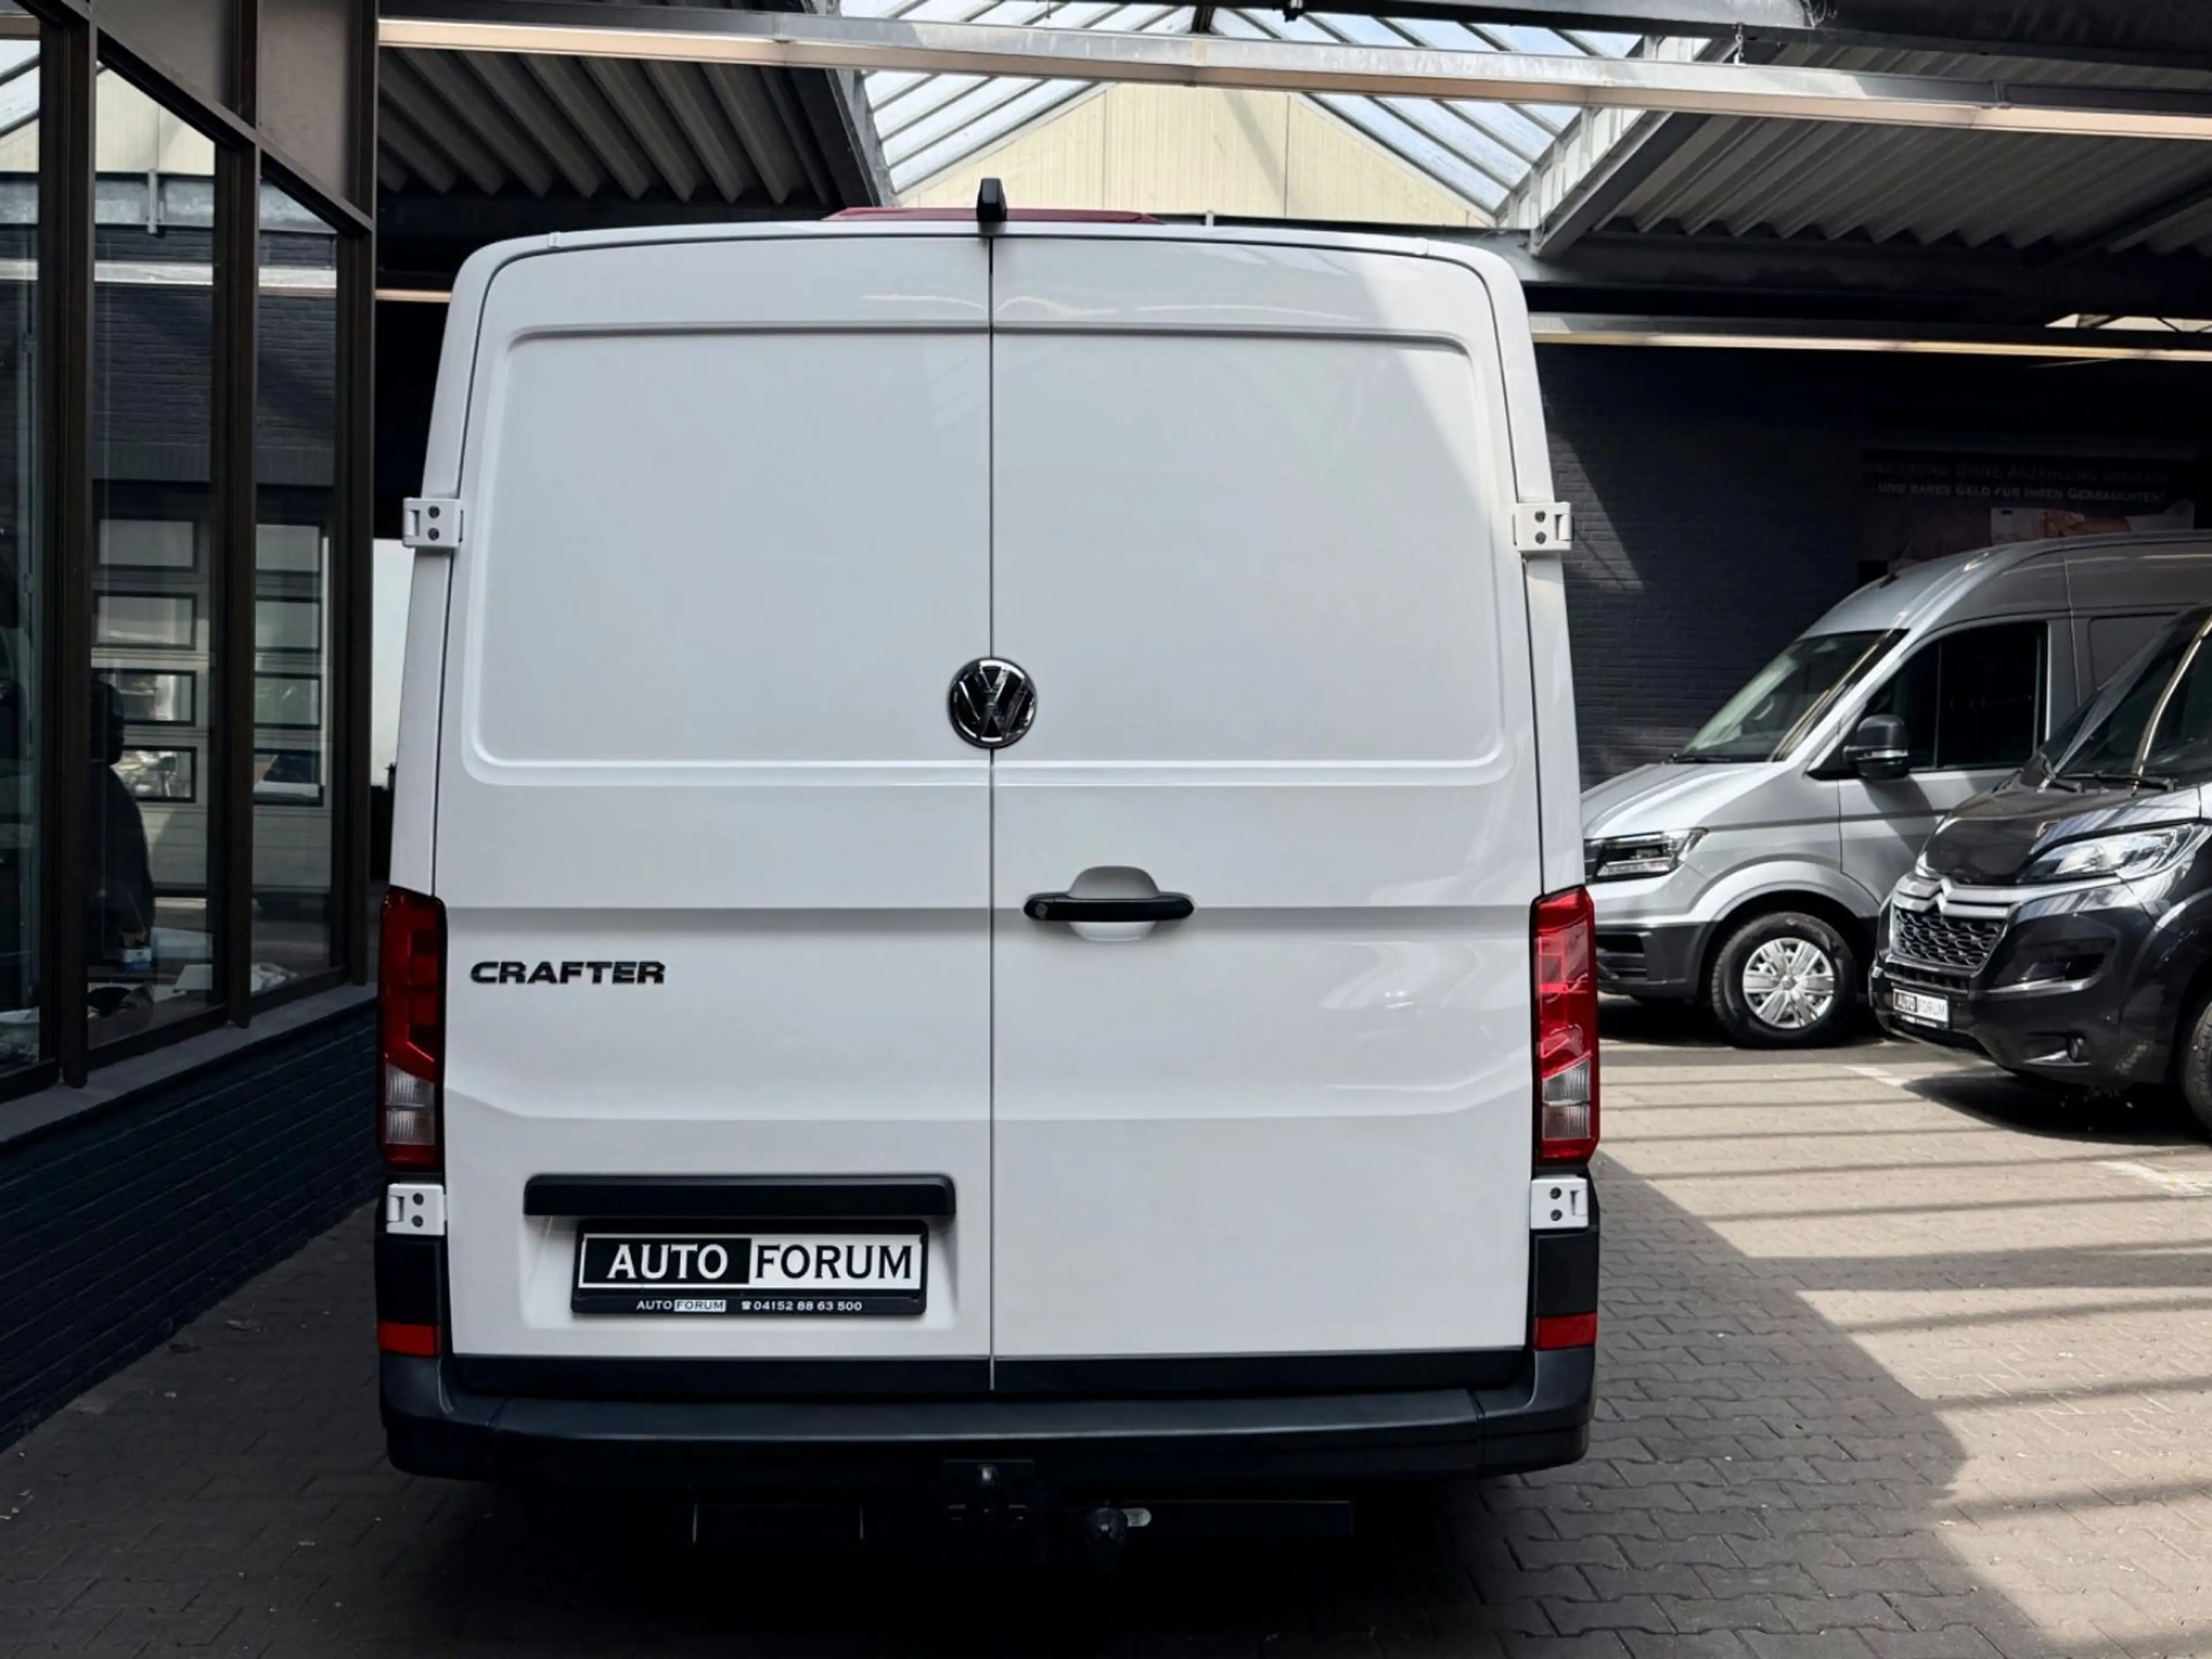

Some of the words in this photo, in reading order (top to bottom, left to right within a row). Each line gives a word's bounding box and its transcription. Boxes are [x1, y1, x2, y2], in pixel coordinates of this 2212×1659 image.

[469, 961, 665, 984] CRAFTER
[606, 1243, 729, 1280] AUTO
[755, 1244, 913, 1281] FORUM
[636, 1300, 673, 1311] AUTO
[676, 1300, 725, 1312] FORUM
[753, 1301, 793, 1311] 04152
[797, 1301, 813, 1311] 88
[817, 1301, 834, 1311] 63
[837, 1301, 863, 1312] 500
